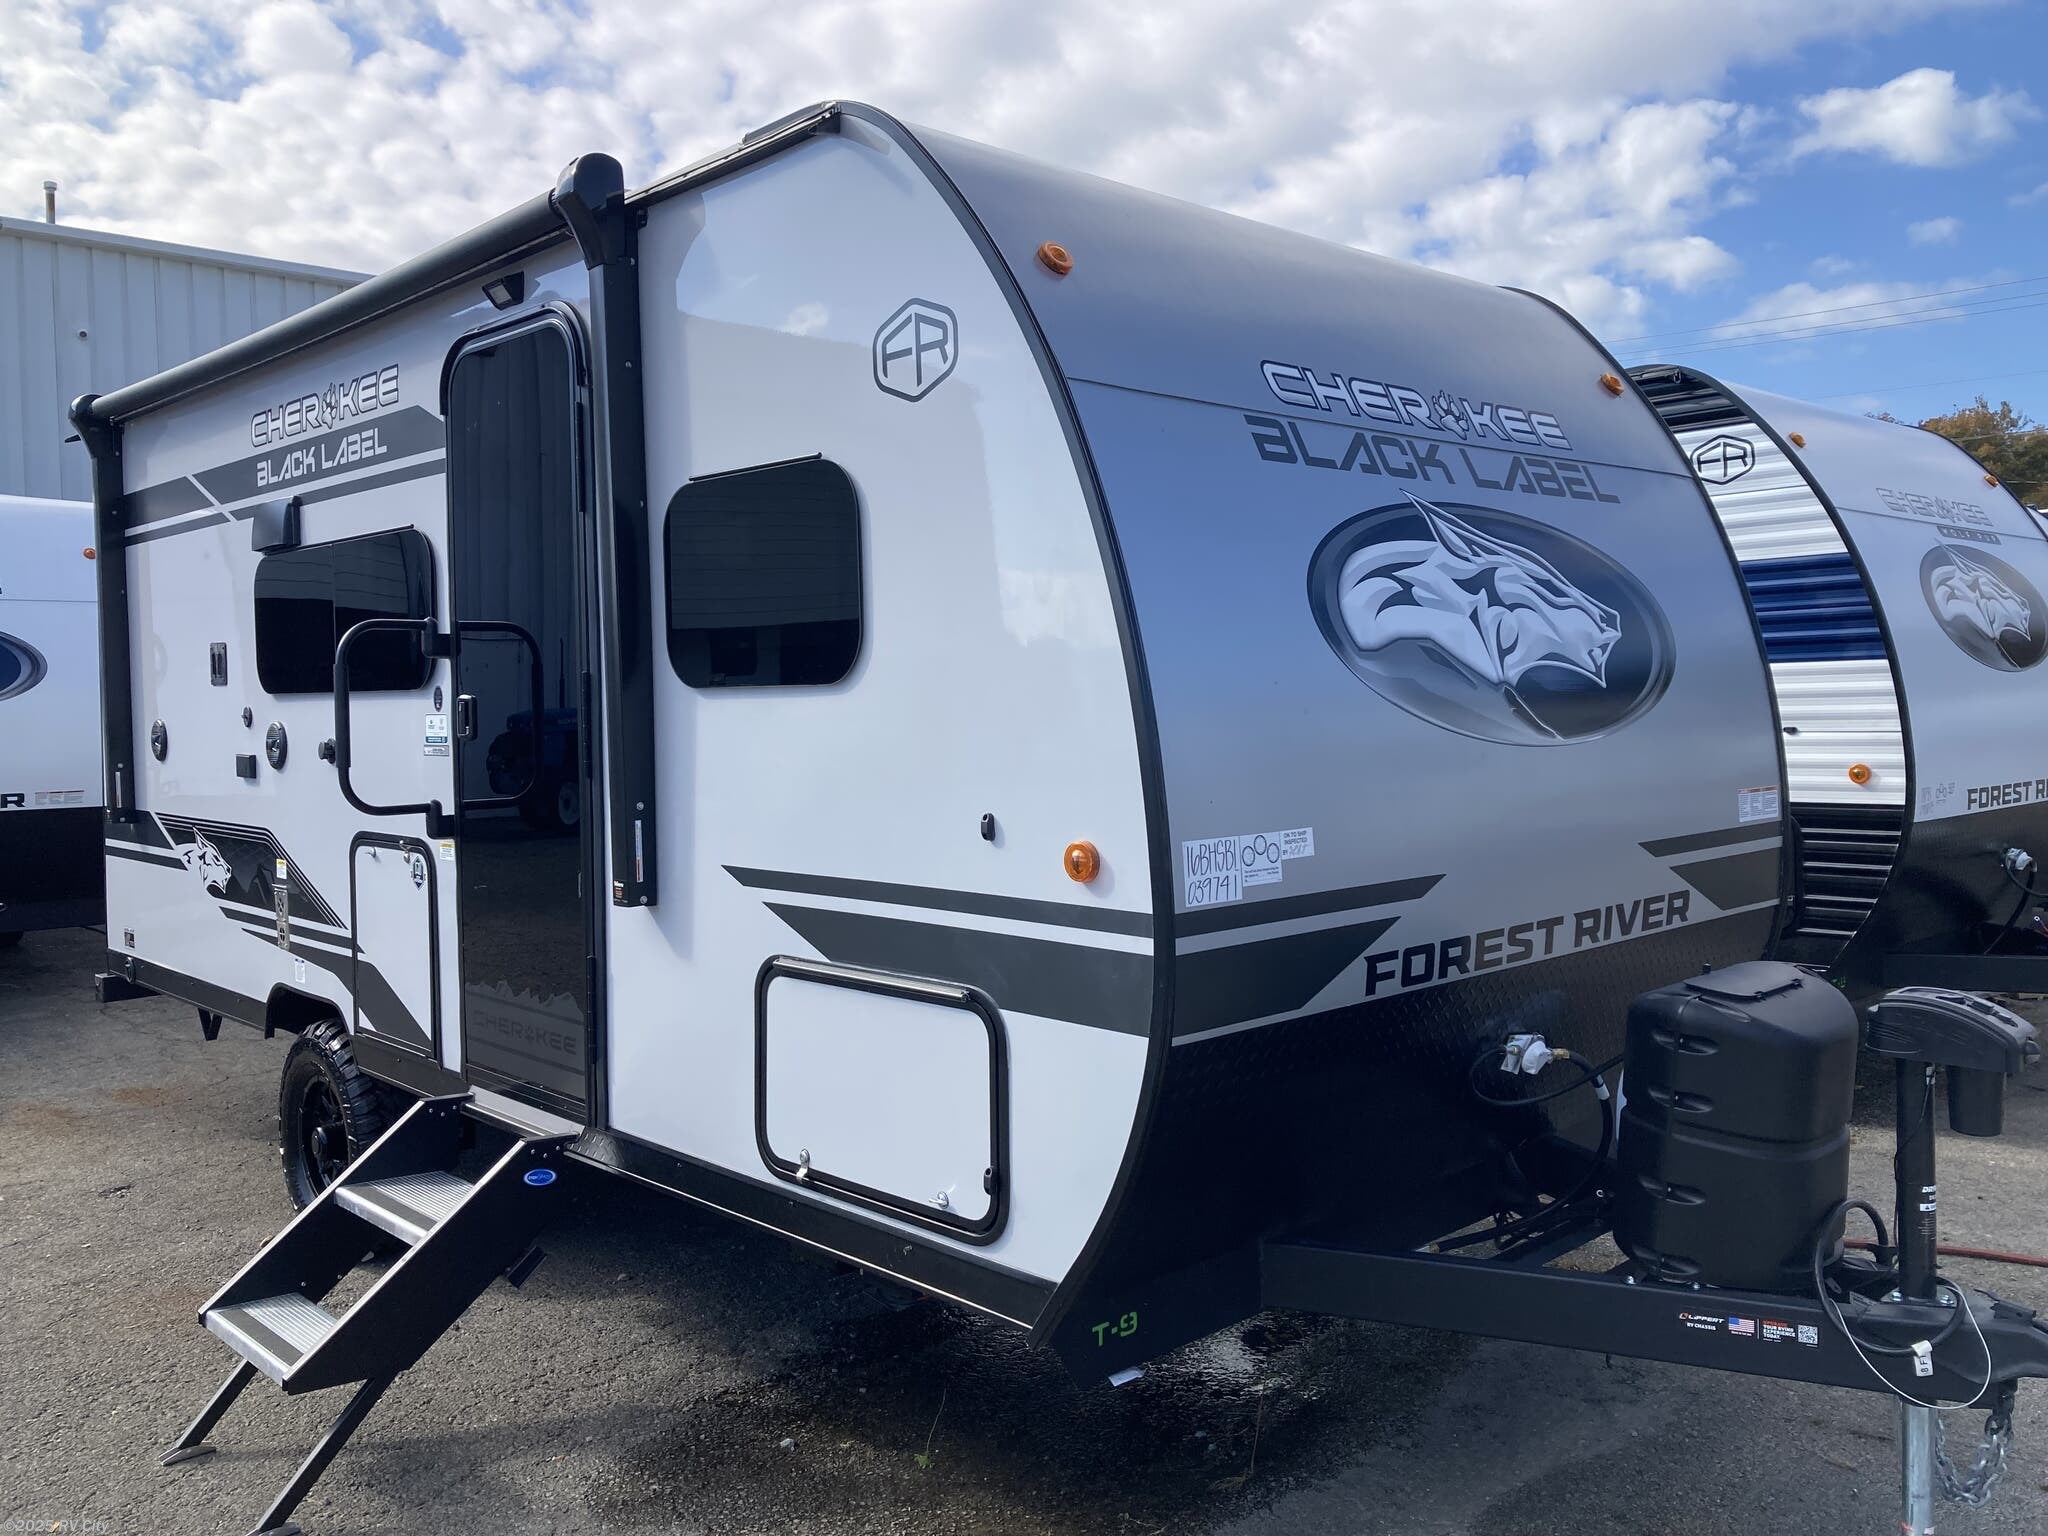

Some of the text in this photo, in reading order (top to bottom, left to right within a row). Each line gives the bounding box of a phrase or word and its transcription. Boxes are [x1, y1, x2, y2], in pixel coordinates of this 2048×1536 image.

[256, 427, 388, 487] BLACK LABEL
[1243, 413, 1621, 504] BLACK LABEL
[1967, 780, 2033, 810] FOREST
[1188, 875, 1237, 905] 039741
[1364, 889, 1691, 996] FOREST RIVER
[1688, 1314, 1726, 1324] LIPPERT
